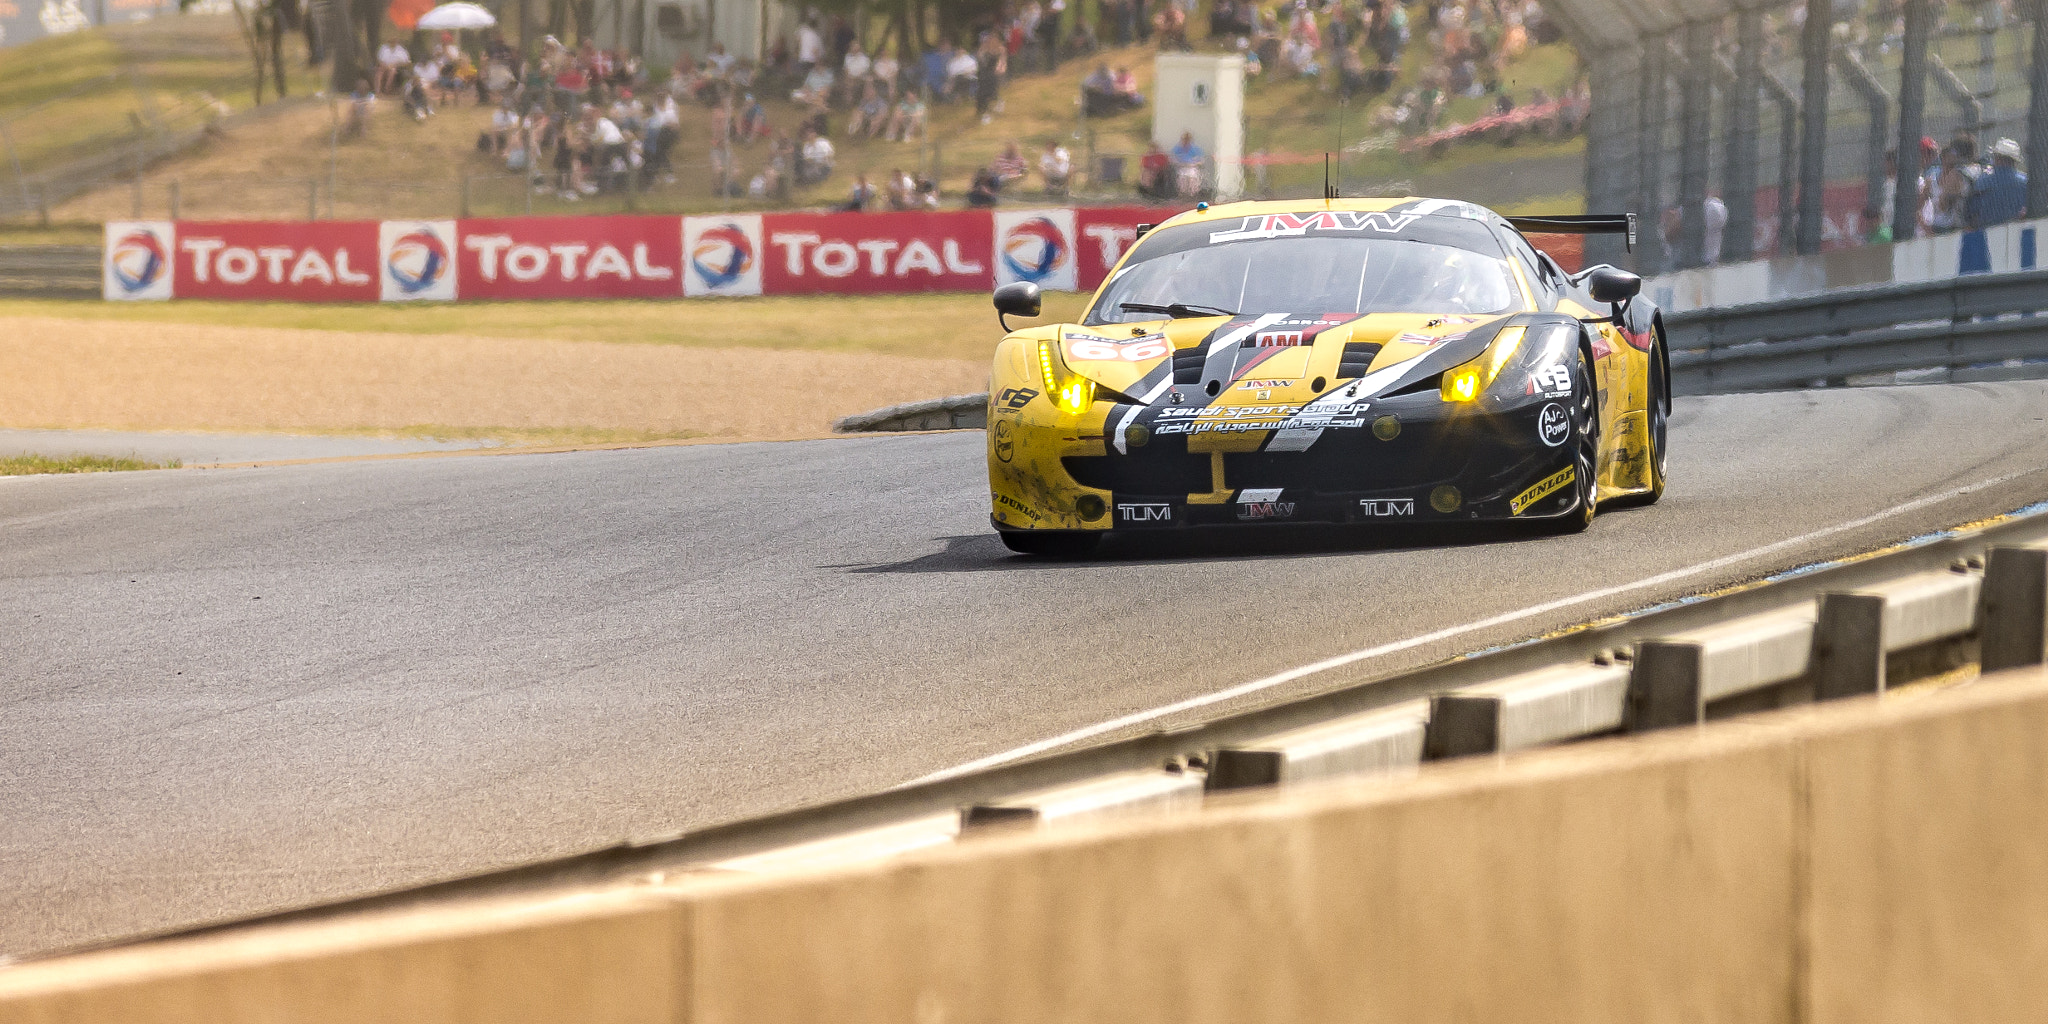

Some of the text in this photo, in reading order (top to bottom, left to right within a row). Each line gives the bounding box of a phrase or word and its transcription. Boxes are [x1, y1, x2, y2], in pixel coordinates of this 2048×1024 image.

[1209, 211, 1421, 243] JMW
[181, 236, 371, 285] TOTAL
[463, 233, 674, 282] TOTAL
[770, 230, 985, 278] TOTAL
[1070, 339, 1167, 362] 66
[1260, 334, 1299, 347] AM
[1237, 380, 1296, 391] JMW
[1158, 405, 1225, 418] Saudi
[1224, 404, 1301, 419] sports
[1544, 410, 1556, 424] AJ
[1519, 468, 1575, 506] DUNLOP
[1000, 495, 1042, 521] DUNLOP
[1117, 503, 1171, 521] TUMI
[1236, 502, 1296, 520] JMW
[1359, 498, 1414, 516] TUMI
